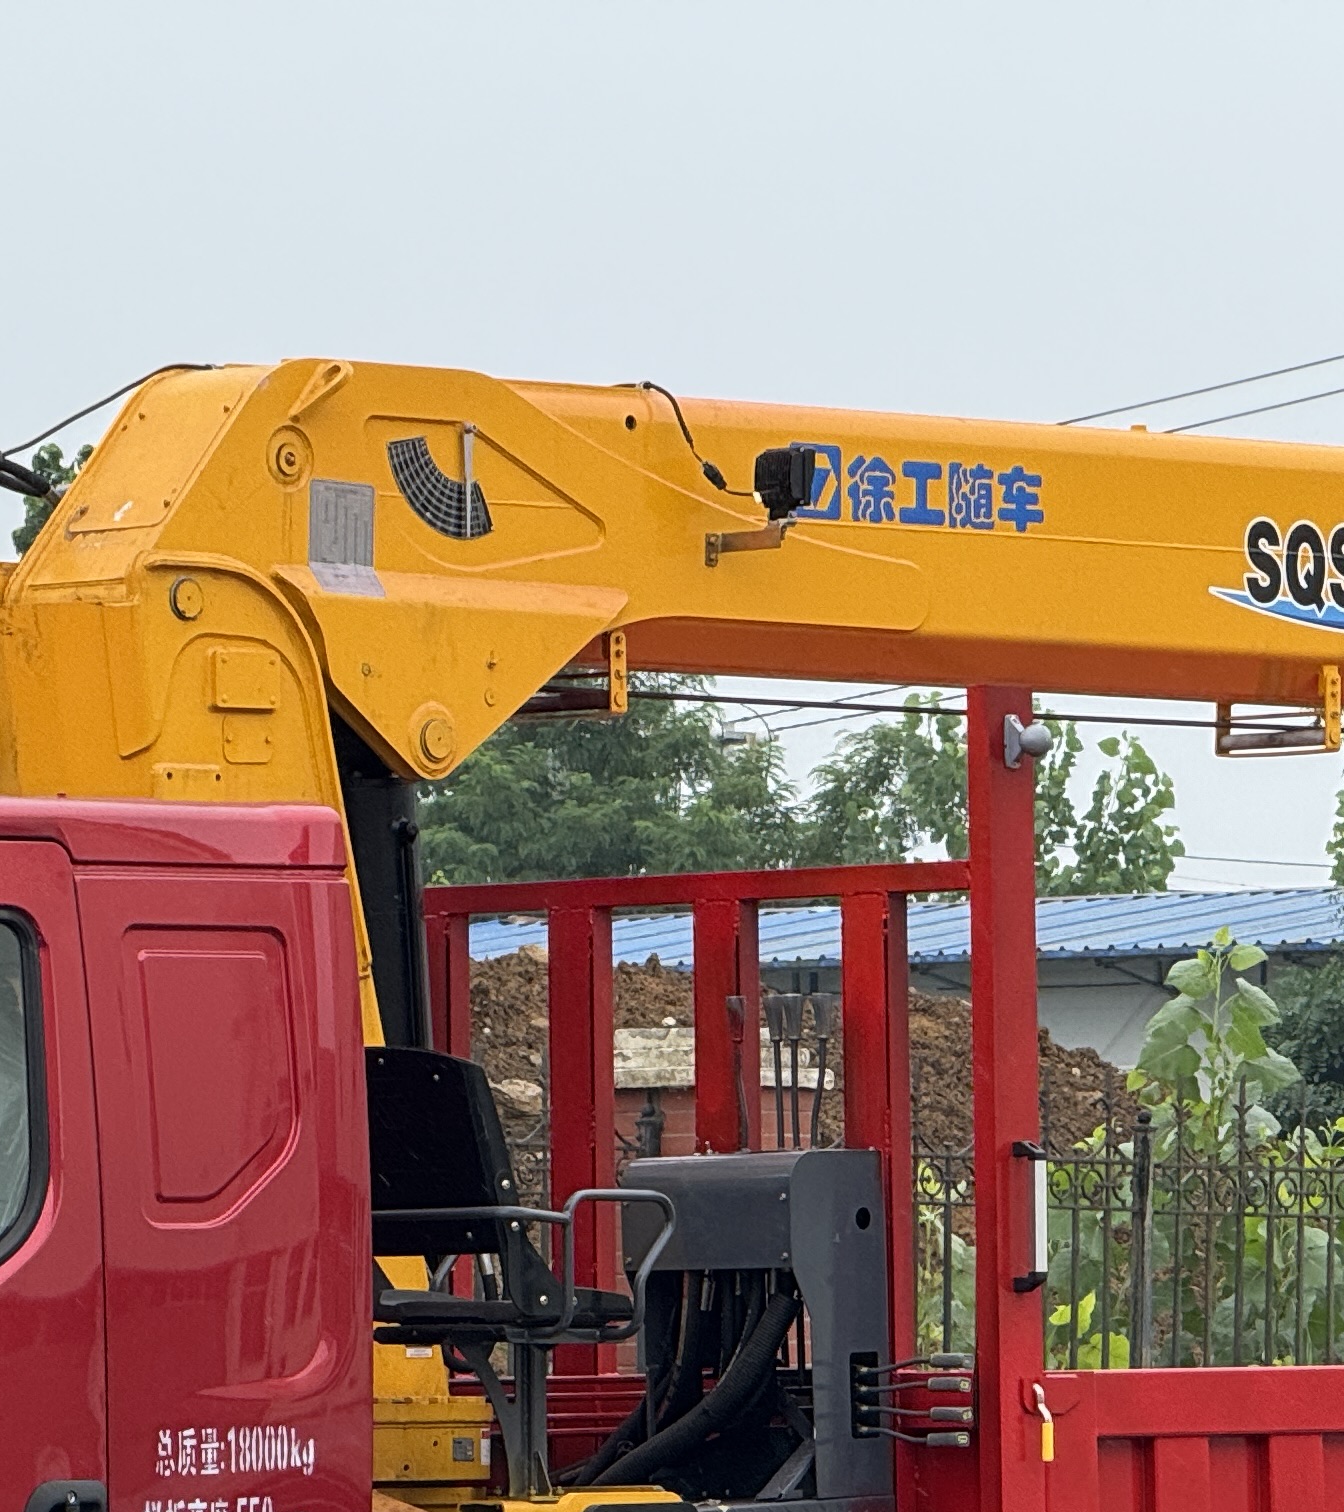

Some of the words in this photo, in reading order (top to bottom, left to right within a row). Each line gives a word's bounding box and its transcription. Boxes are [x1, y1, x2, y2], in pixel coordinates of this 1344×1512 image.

[847, 455, 1044, 533] 徐工随车
[156, 1424, 315, 1477] 总质量:18000kg
